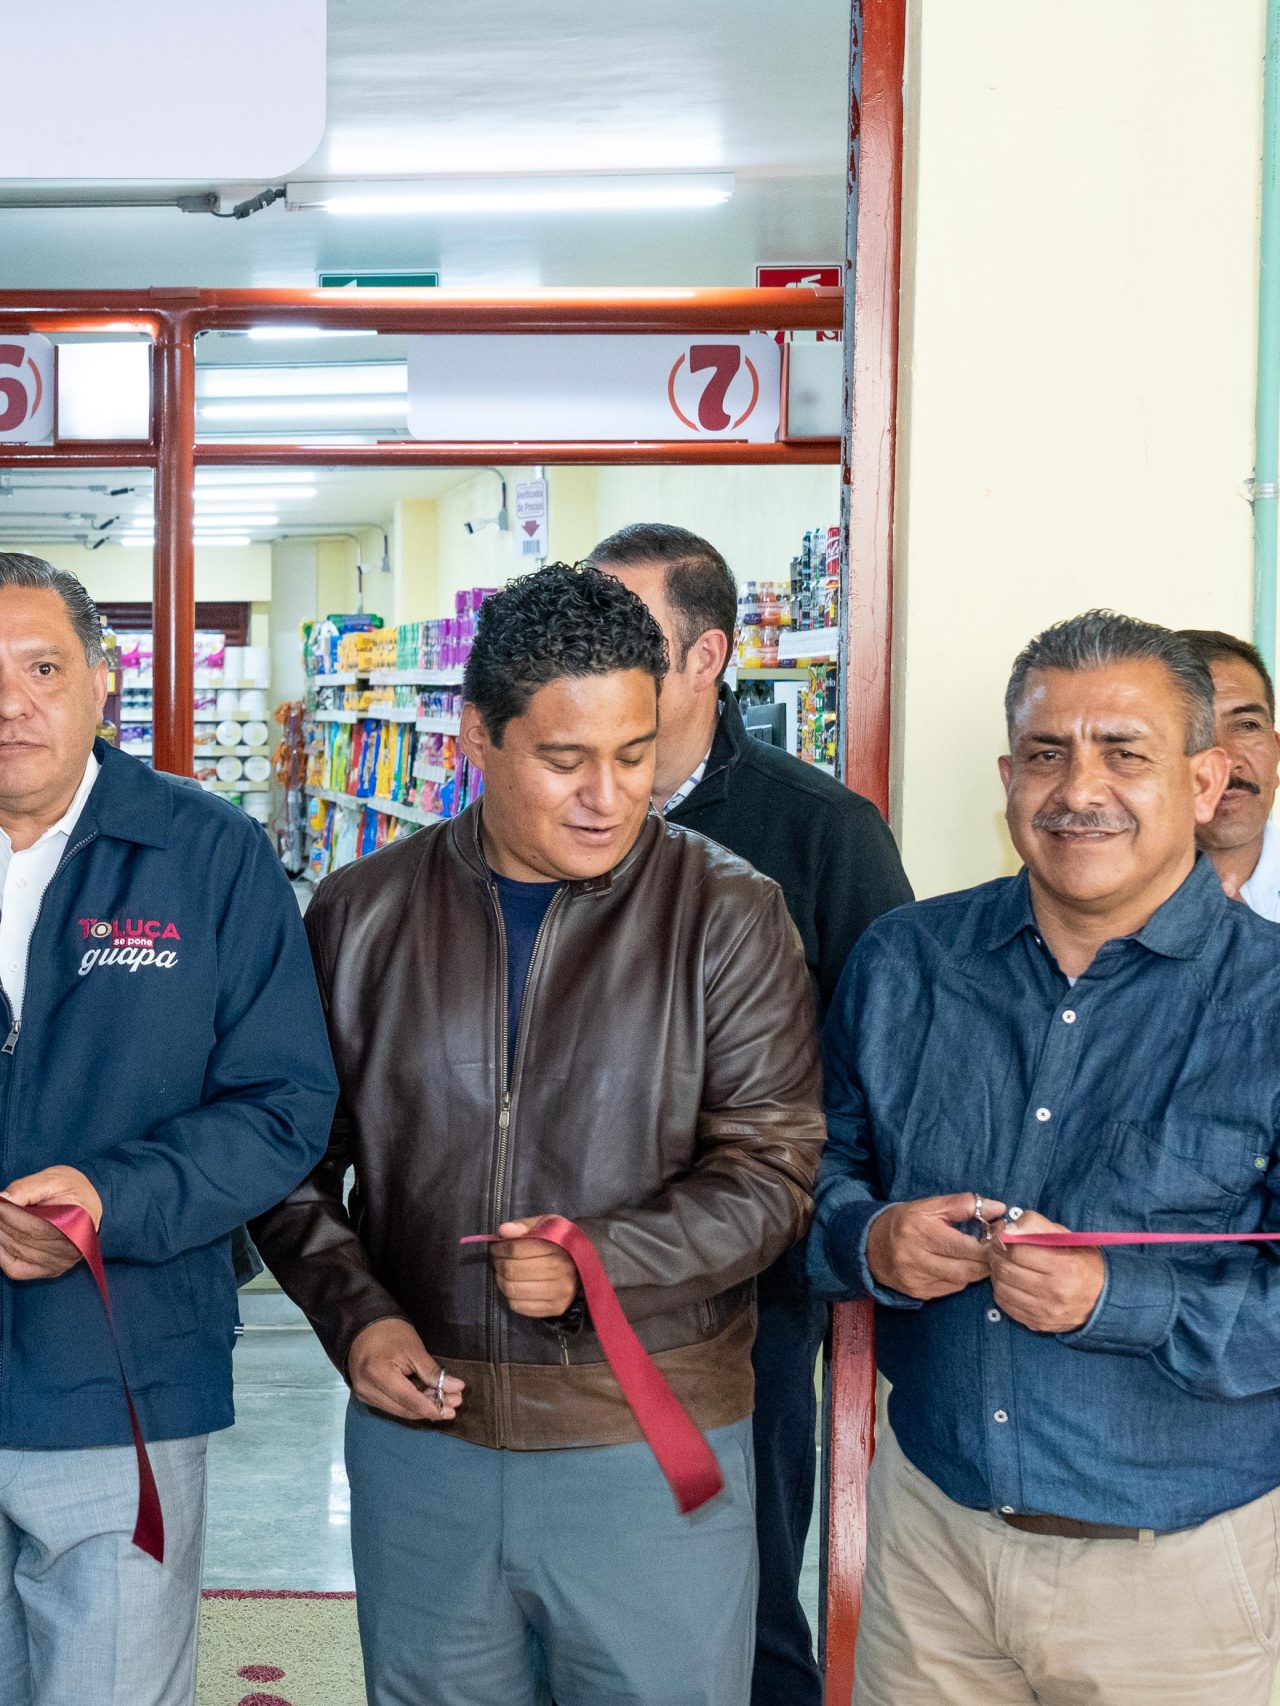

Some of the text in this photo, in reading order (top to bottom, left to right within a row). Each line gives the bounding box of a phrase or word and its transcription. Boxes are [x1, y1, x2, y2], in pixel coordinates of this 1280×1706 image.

[77, 918, 181, 940] TOLUCA
[113, 937, 154, 948] se pone
[77, 946, 179, 976] guapa
